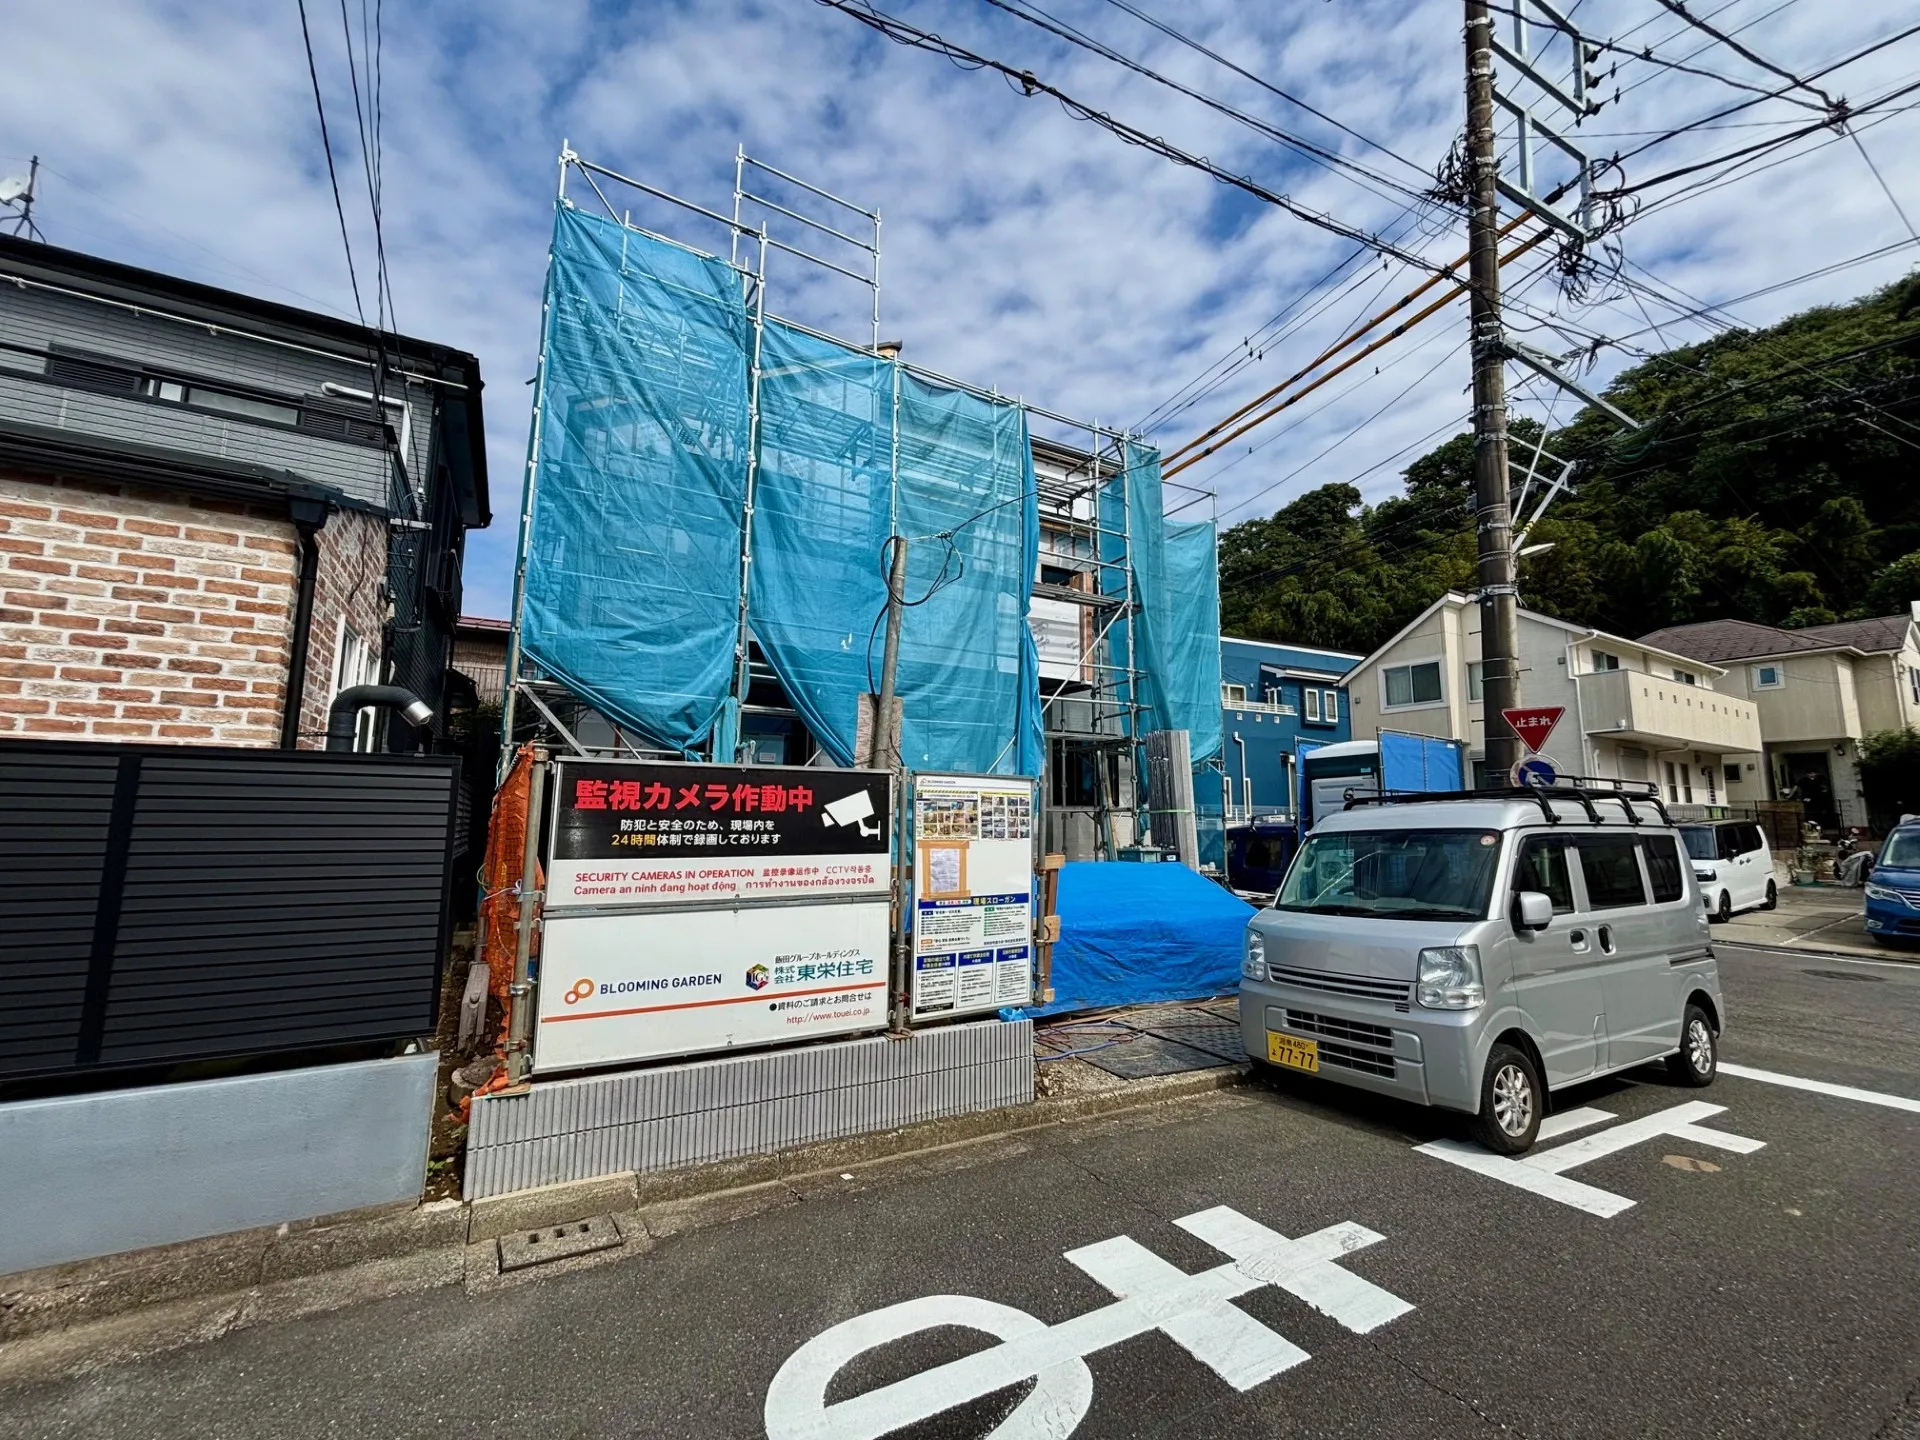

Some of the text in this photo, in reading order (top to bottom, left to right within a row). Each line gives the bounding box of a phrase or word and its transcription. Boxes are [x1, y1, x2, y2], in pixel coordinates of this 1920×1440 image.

[1515, 716, 1552, 728] 止まれ
[574, 780, 813, 813] 監視カメラ作動中
[620, 819, 775, 831] 防犯と安全のため、現場内を
[611, 833, 781, 846] 24時間体制で録画しております
[575, 869, 754, 882] SECURITY CAMERAS IN OPERATION
[573, 881, 736, 896] Camera an ninh đang hoạt động
[775, 948, 860, 964] 飯田グループホールディングス
[774, 965, 795, 974] 株式
[797, 959, 873, 981] 東栄住宅
[600, 973, 722, 995] BLOOMING GARDEN
[774, 974, 795, 984] 会社
[777, 992, 872, 1011] 資料のご請求とお問合せは
[786, 1008, 870, 1024] http://www.touei.co.jp
[1278, 1046, 1314, 1069] 77-77
